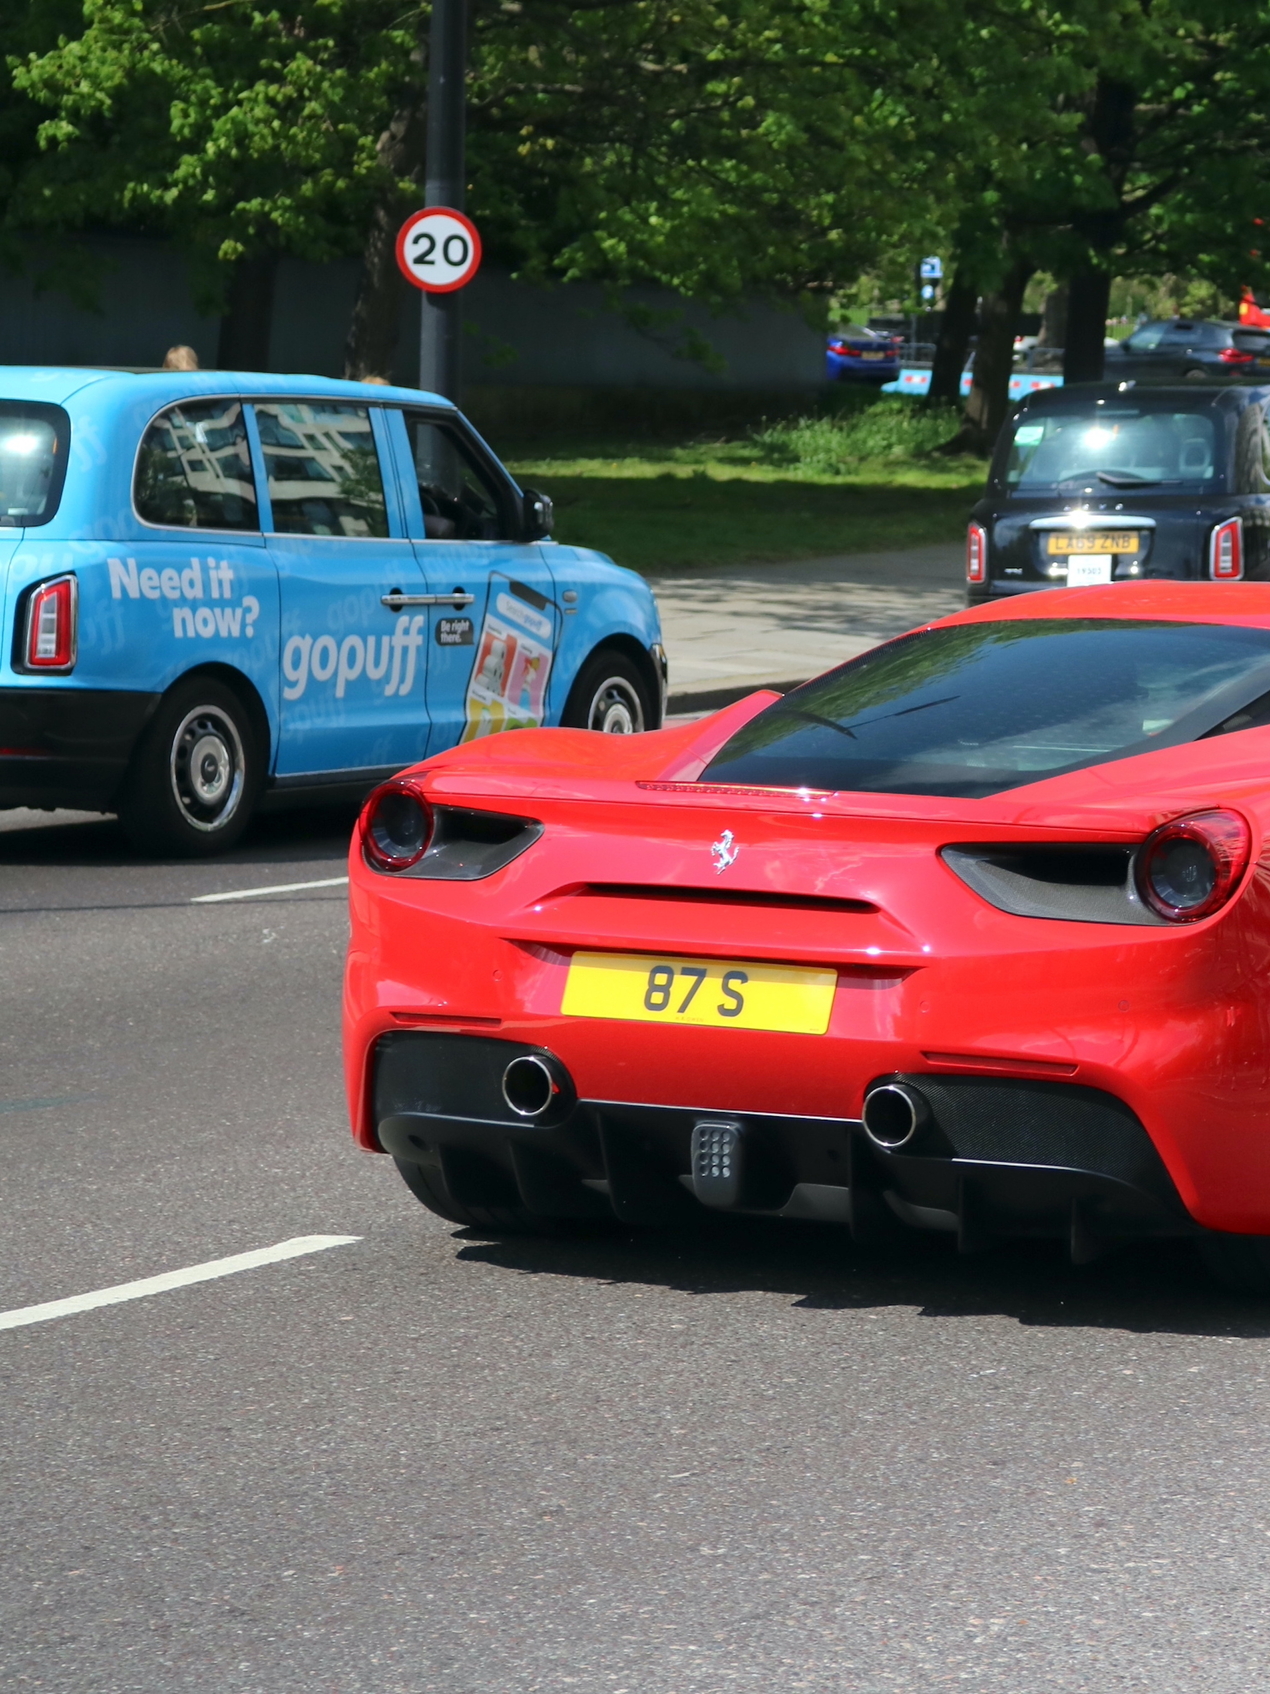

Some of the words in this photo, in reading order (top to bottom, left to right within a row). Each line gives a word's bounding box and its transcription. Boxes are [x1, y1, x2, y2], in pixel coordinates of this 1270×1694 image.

[412, 232, 469, 266] 20
[1100, 532, 1131, 549] ZNB
[107, 557, 204, 600] Need
[207, 556, 234, 599] it
[173, 595, 260, 639] now?
[440, 620, 451, 632] Be
[451, 619, 470, 634] right
[440, 632, 462, 643] there.
[282, 615, 425, 700] gopuff
[644, 965, 707, 1013] 87
[717, 970, 748, 1017] S
